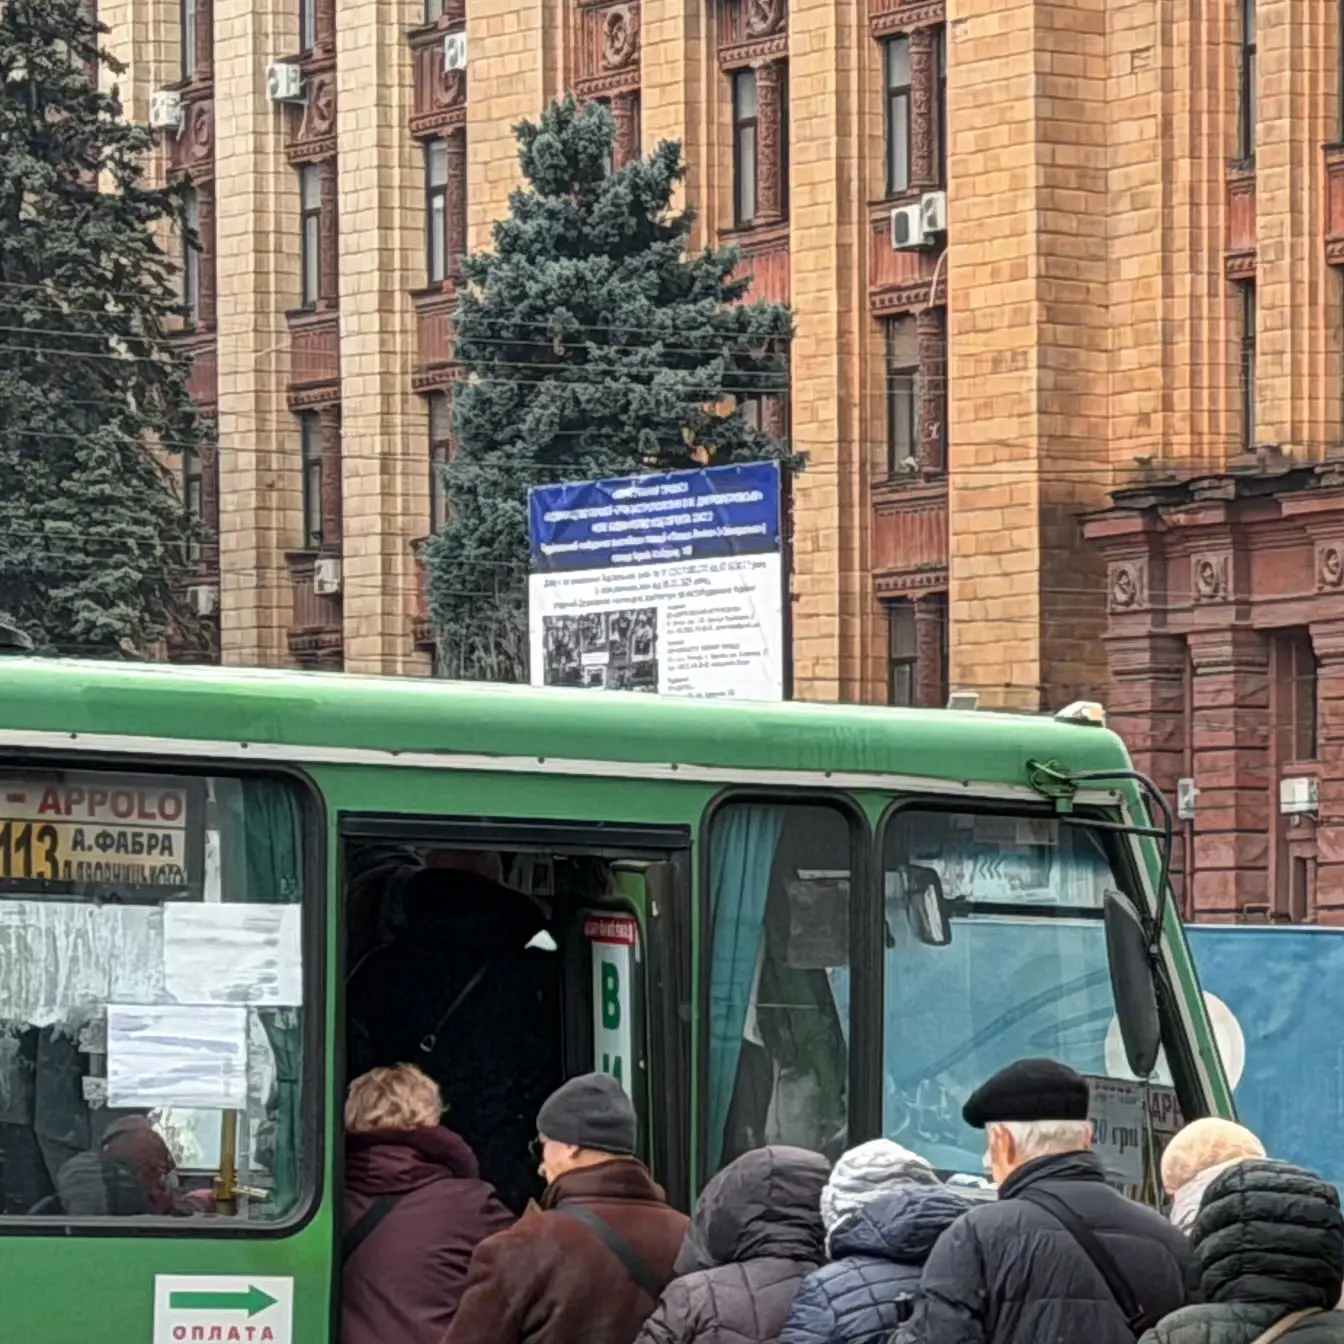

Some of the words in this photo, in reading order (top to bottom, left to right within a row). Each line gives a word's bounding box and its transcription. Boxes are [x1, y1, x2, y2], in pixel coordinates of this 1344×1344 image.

[37, 785, 183, 821] APPOLO
[0, 822, 59, 881] 113
[172, 1325, 274, 1341] ОПЛАТА
